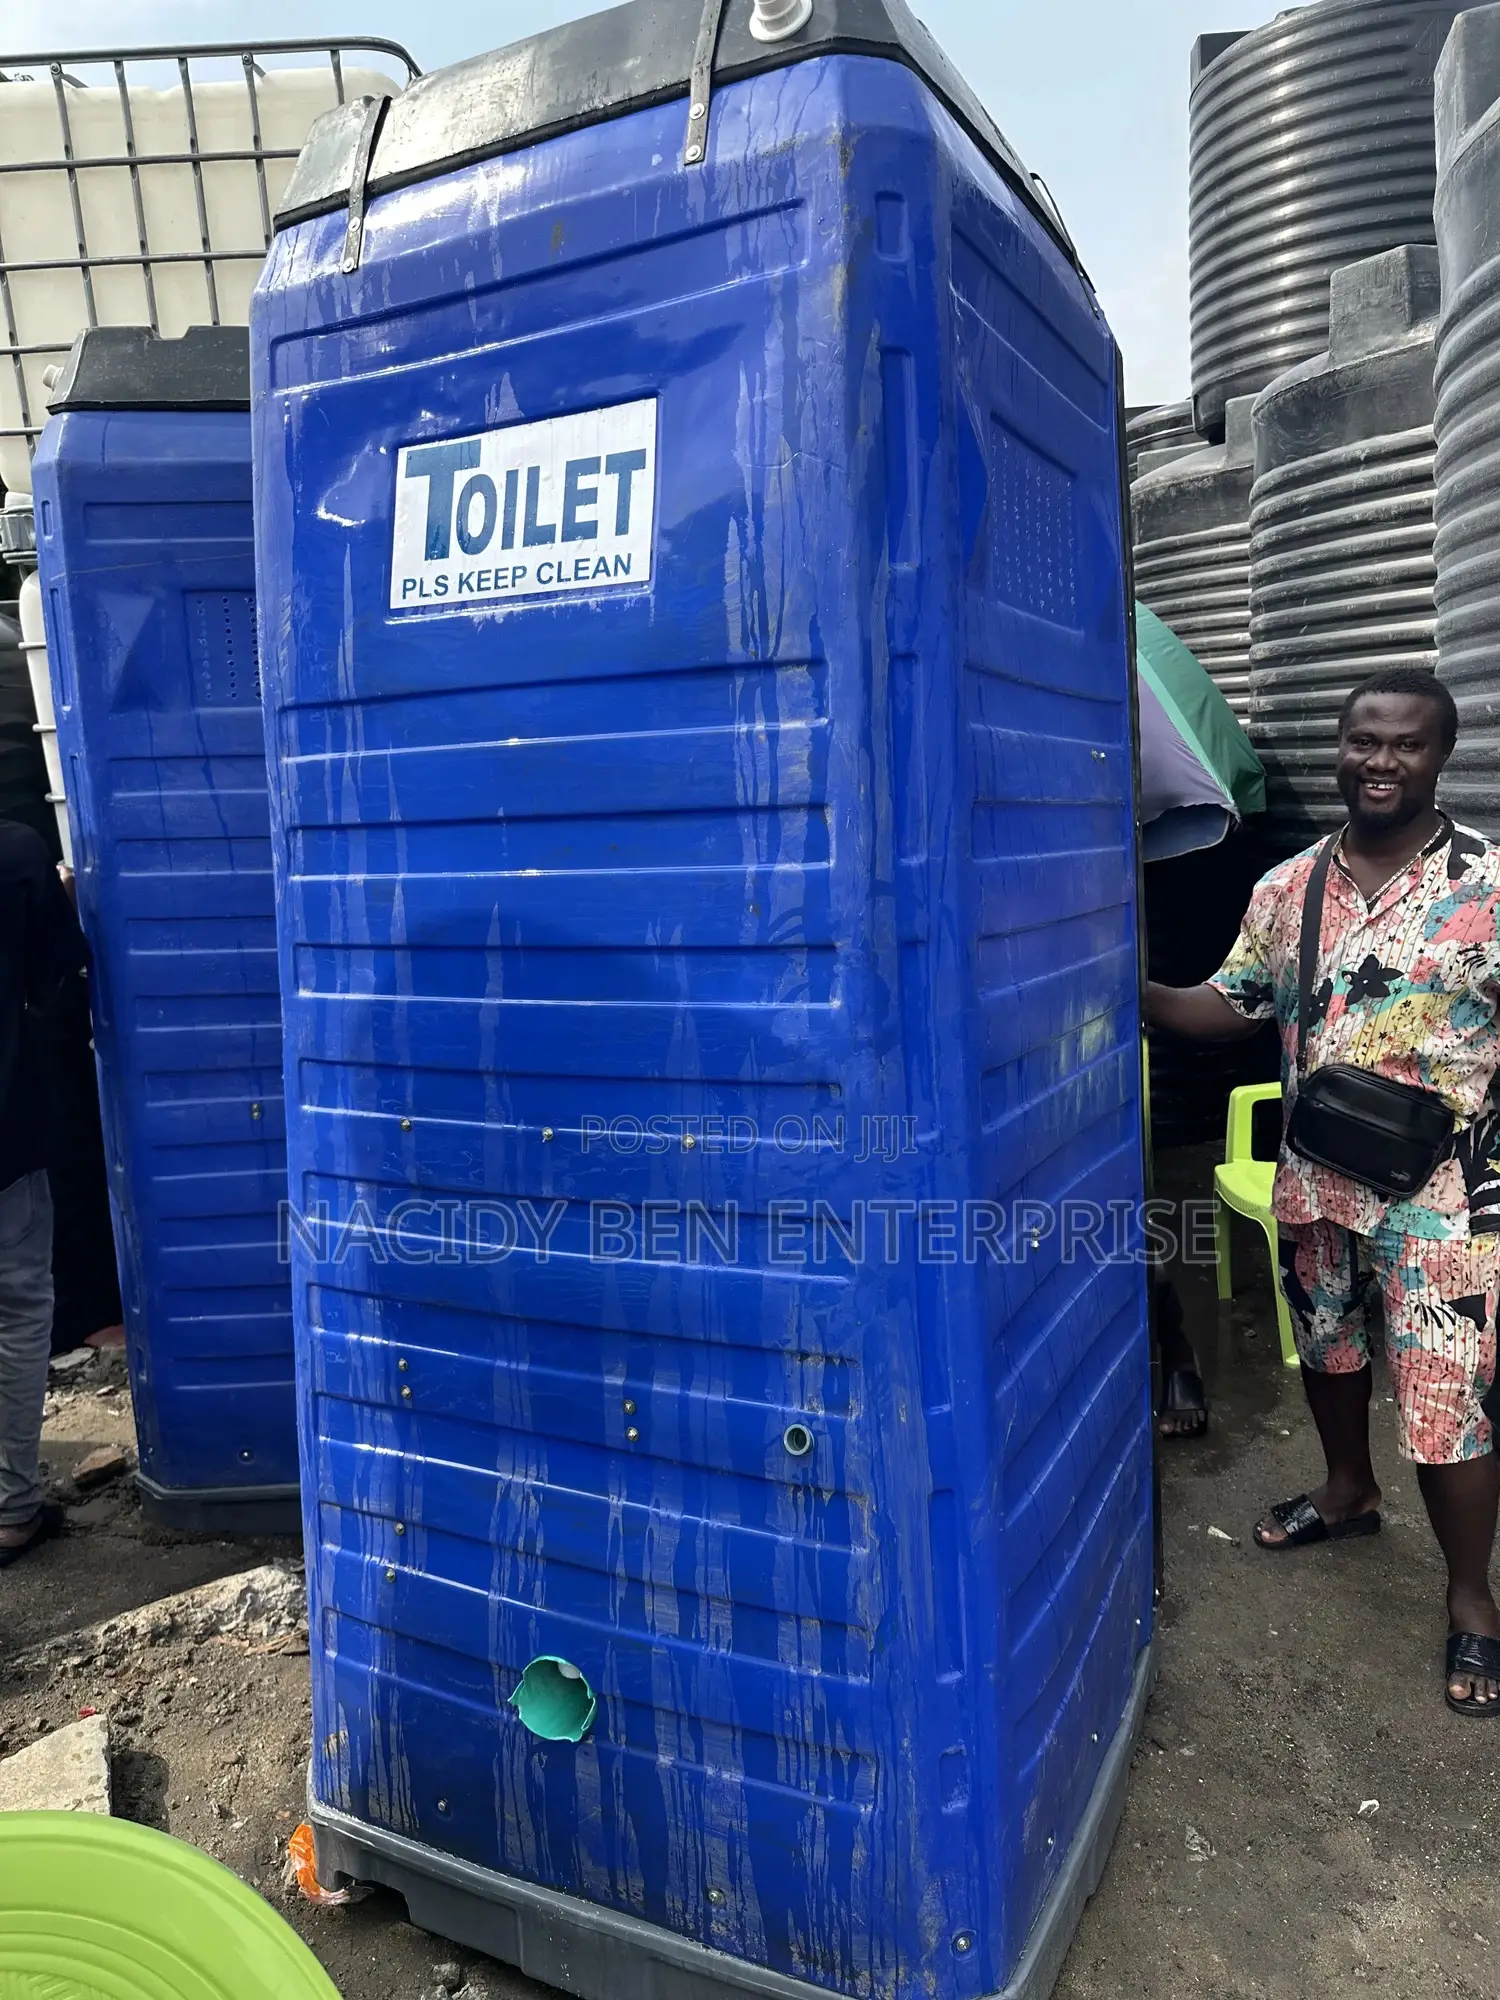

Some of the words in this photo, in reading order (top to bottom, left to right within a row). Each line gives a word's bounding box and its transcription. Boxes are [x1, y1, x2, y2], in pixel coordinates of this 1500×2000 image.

[405, 438, 647, 561] TOILET
[402, 574, 449, 600] PLS
[458, 565, 527, 594] KEEP
[536, 553, 632, 585] CLEAN
